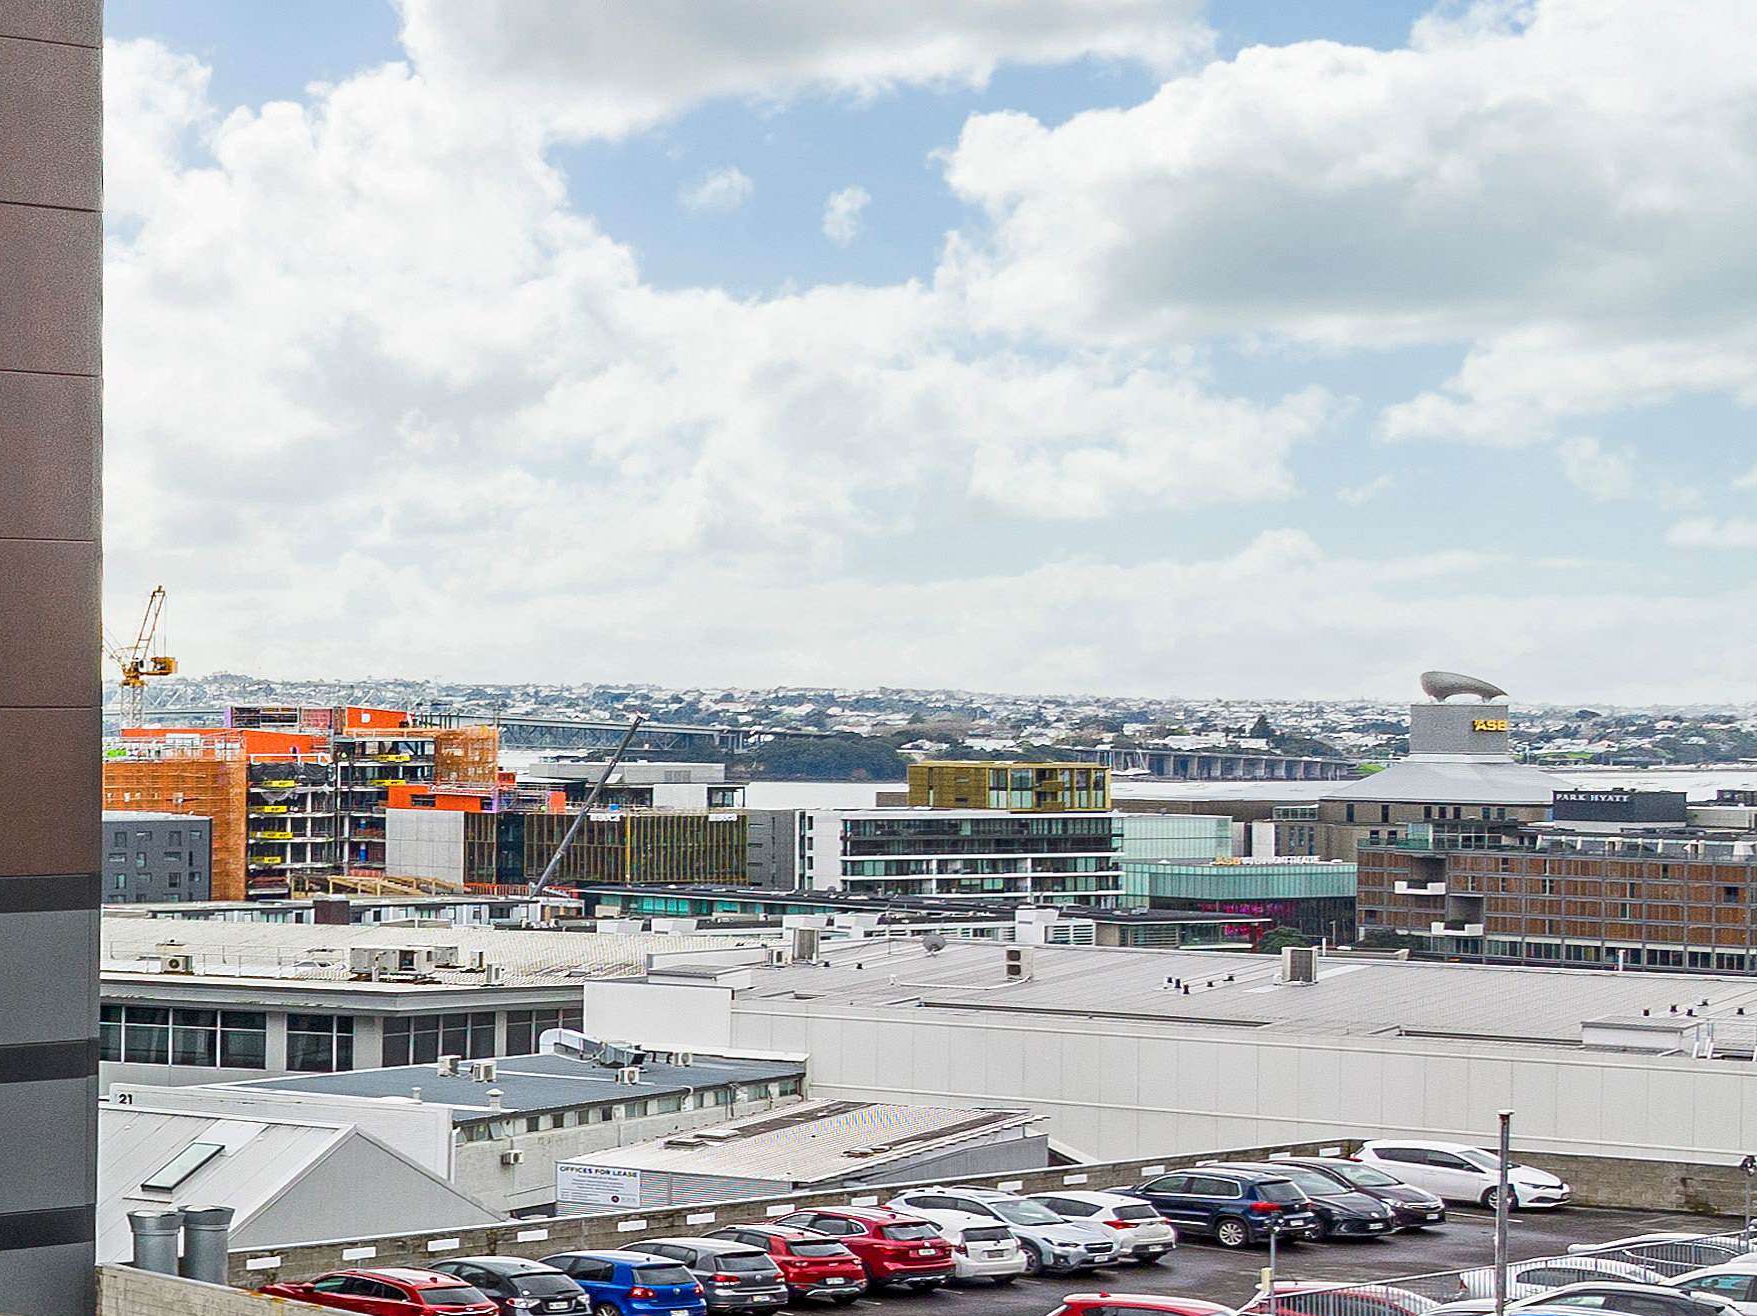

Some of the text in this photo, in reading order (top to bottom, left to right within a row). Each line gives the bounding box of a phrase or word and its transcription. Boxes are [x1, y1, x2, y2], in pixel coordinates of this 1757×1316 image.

[1590, 794, 1630, 802] HYATT
[118, 1093, 133, 1105] 21
[559, 1166, 593, 1174] OFFICES
[612, 1170, 638, 1178] LEASE
